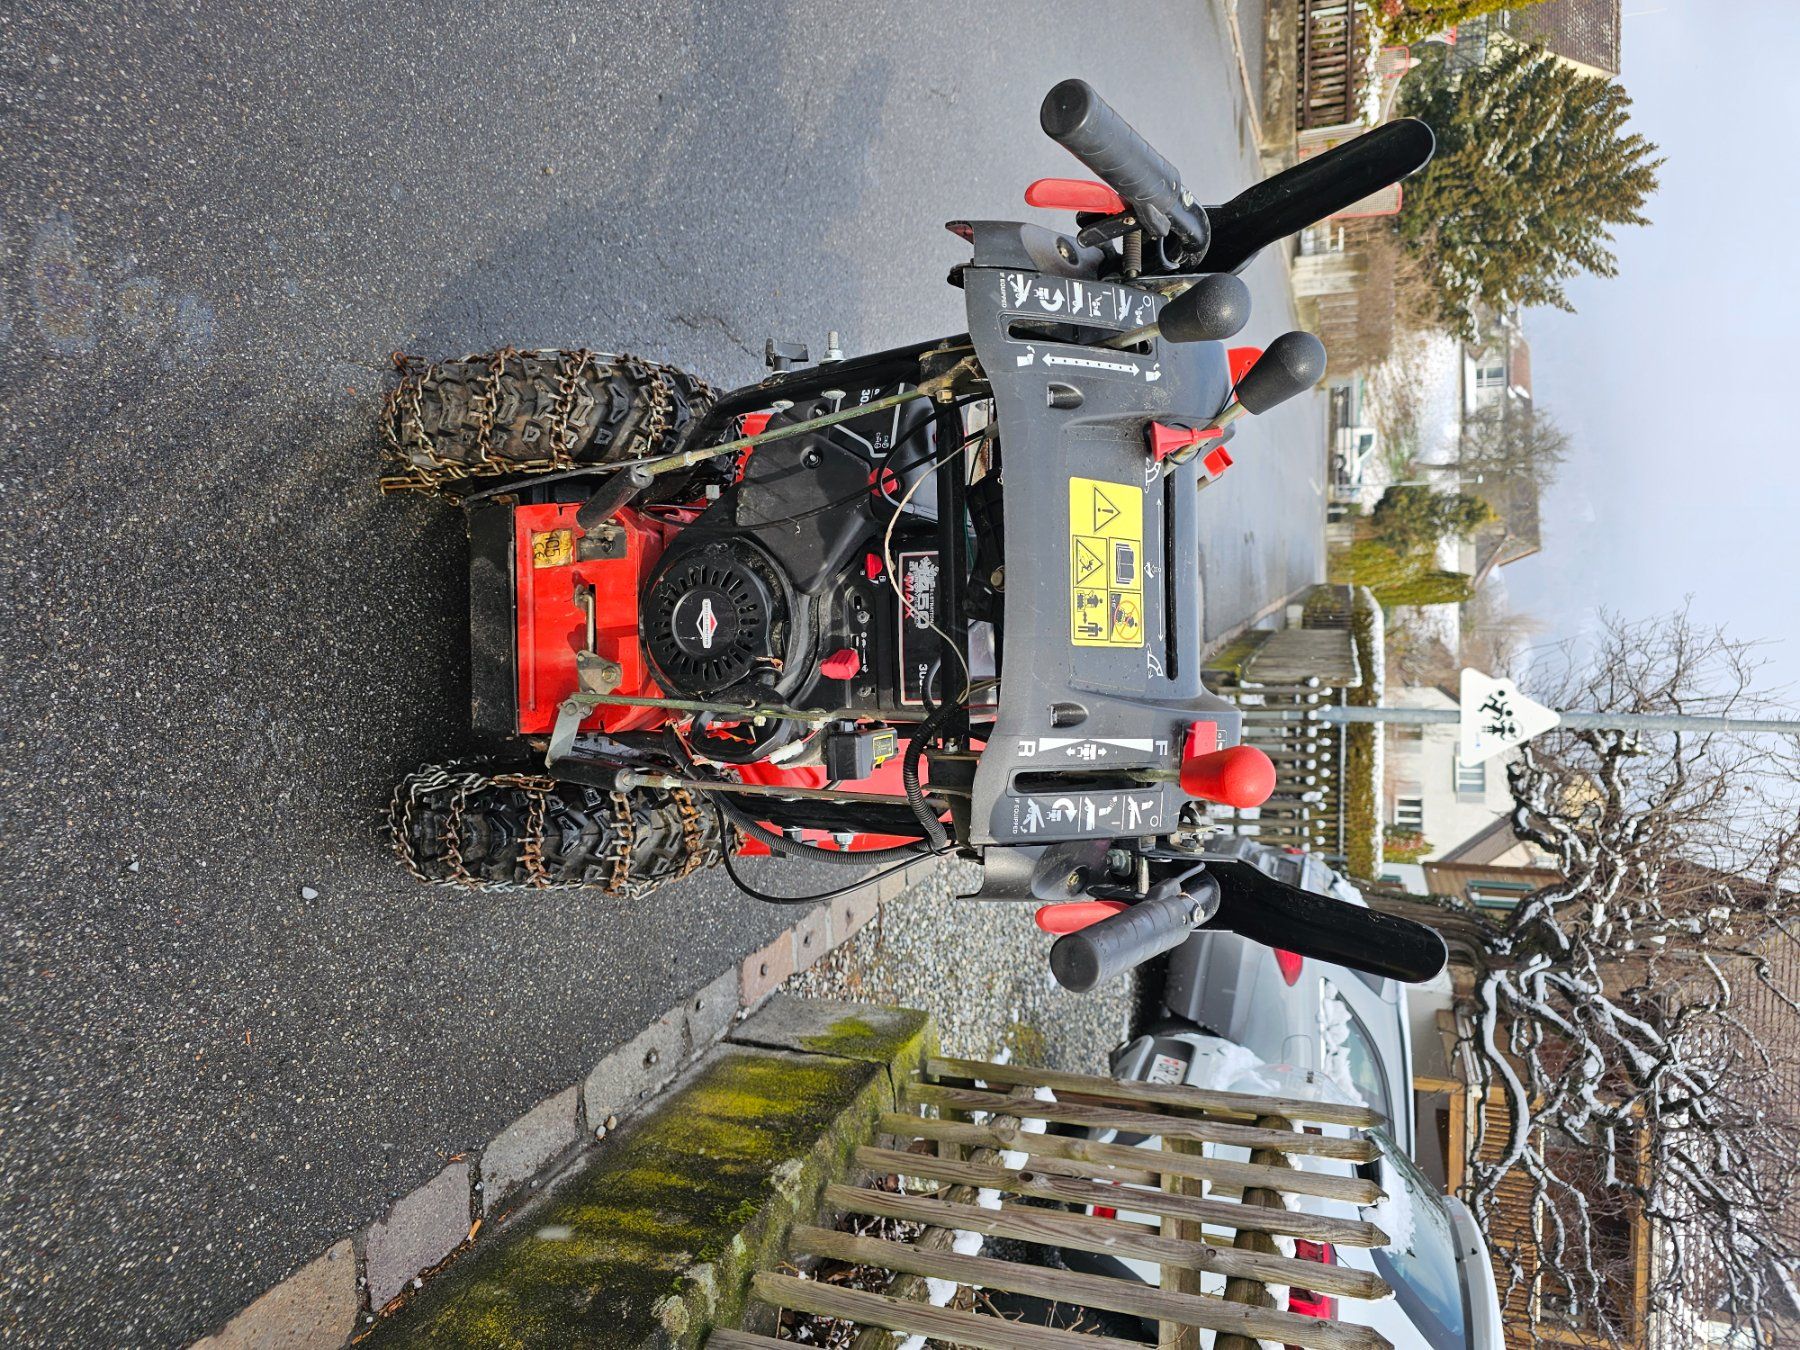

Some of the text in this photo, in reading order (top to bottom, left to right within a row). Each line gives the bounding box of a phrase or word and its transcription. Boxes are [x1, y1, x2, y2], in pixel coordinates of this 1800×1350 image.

[1019, 740, 1036, 756] R
[1156, 740, 1168, 756] F
[1012, 804, 1020, 834] EQUIPPED
